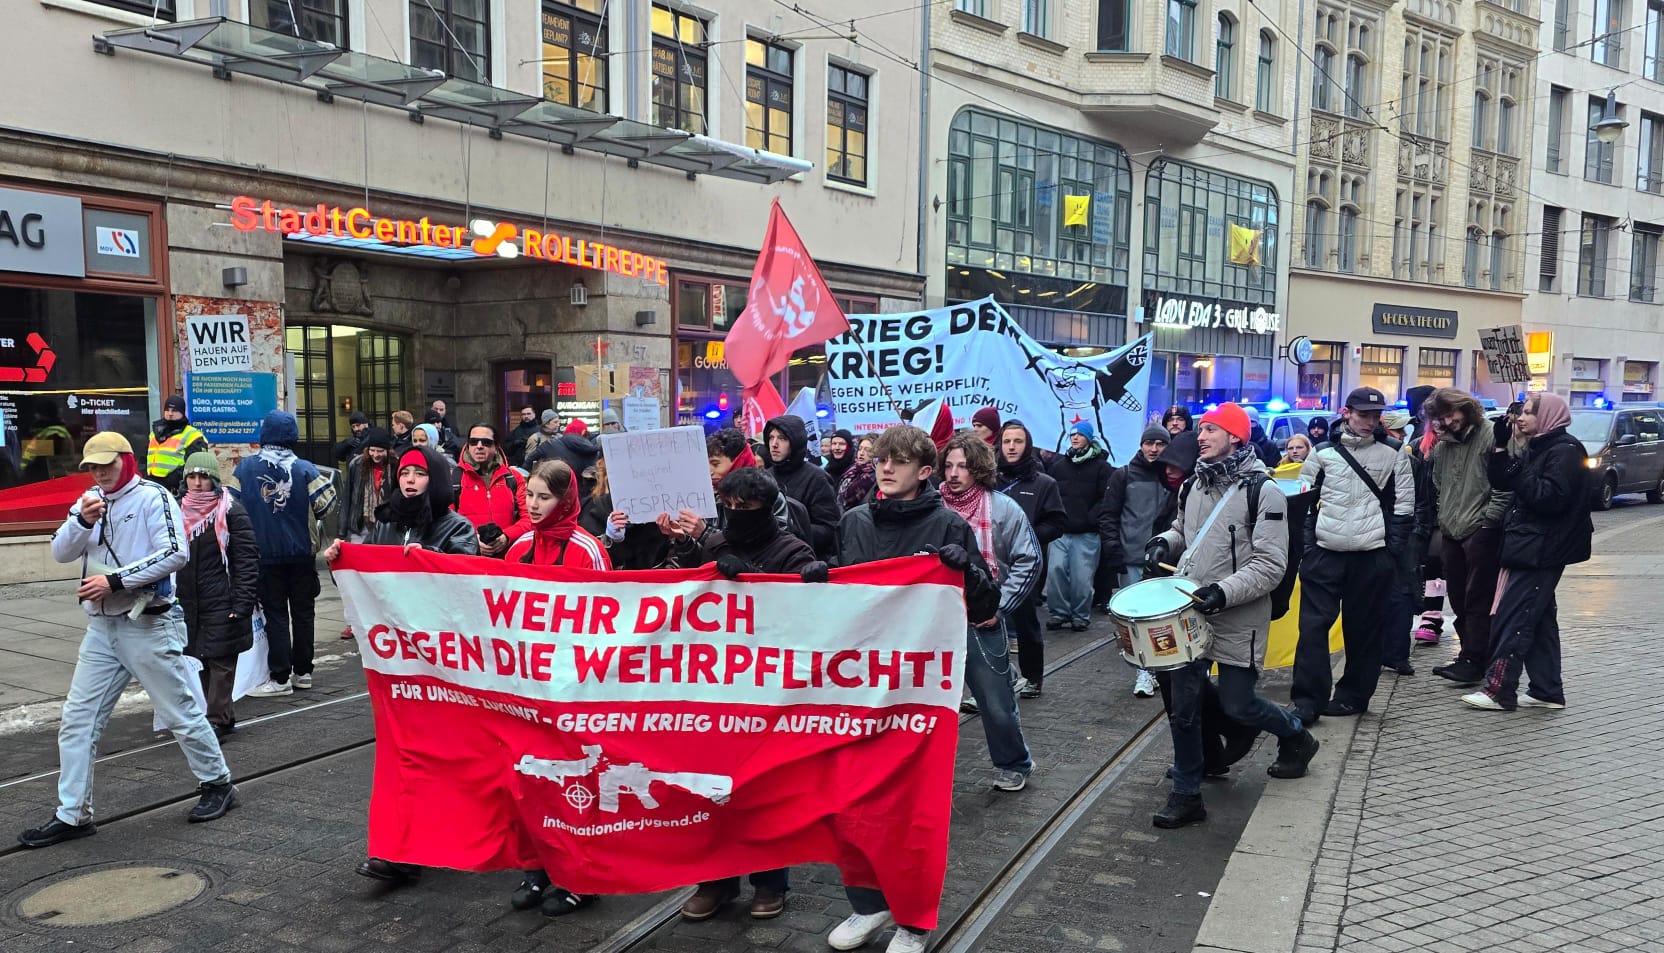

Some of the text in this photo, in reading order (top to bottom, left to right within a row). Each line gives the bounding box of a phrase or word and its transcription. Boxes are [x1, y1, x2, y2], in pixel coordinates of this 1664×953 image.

[230, 195, 669, 286] StadtCenter ROLLTREPPE
[1154, 296, 1187, 325] LADY
[1188, 301, 1213, 328] EDA
[1212, 303, 1222, 329] 3
[1382, 312, 1452, 329] SHOES & THE CITY
[191, 321, 247, 345] WIR
[194, 345, 249, 356] HAUEN AUF
[195, 355, 250, 367] DEN PUTZ!
[694, 356, 729, 369] GOUR
[827, 344, 945, 380] KRIEG!
[80, 399, 115, 407] D-TICKET
[192, 398, 212, 406] BÜRO,
[831, 386, 864, 398] EGEN
[869, 385, 893, 397] DIE
[482, 588, 755, 635] WEHR DICH
[367, 624, 954, 691] GEGEN DIE WEHRPFLICHT!
[391, 682, 424, 700] FÜR
[426, 685, 480, 707] UNSERE
[479, 697, 540, 723] ZUKUNFT
[556, 712, 636, 733] GEGEN
[641, 712, 712, 733] KRIEG
[718, 714, 767, 733] UND
[773, 711, 939, 737] AUFRÜSTUNG!
[542, 811, 711, 837] internationale-jugend.de
